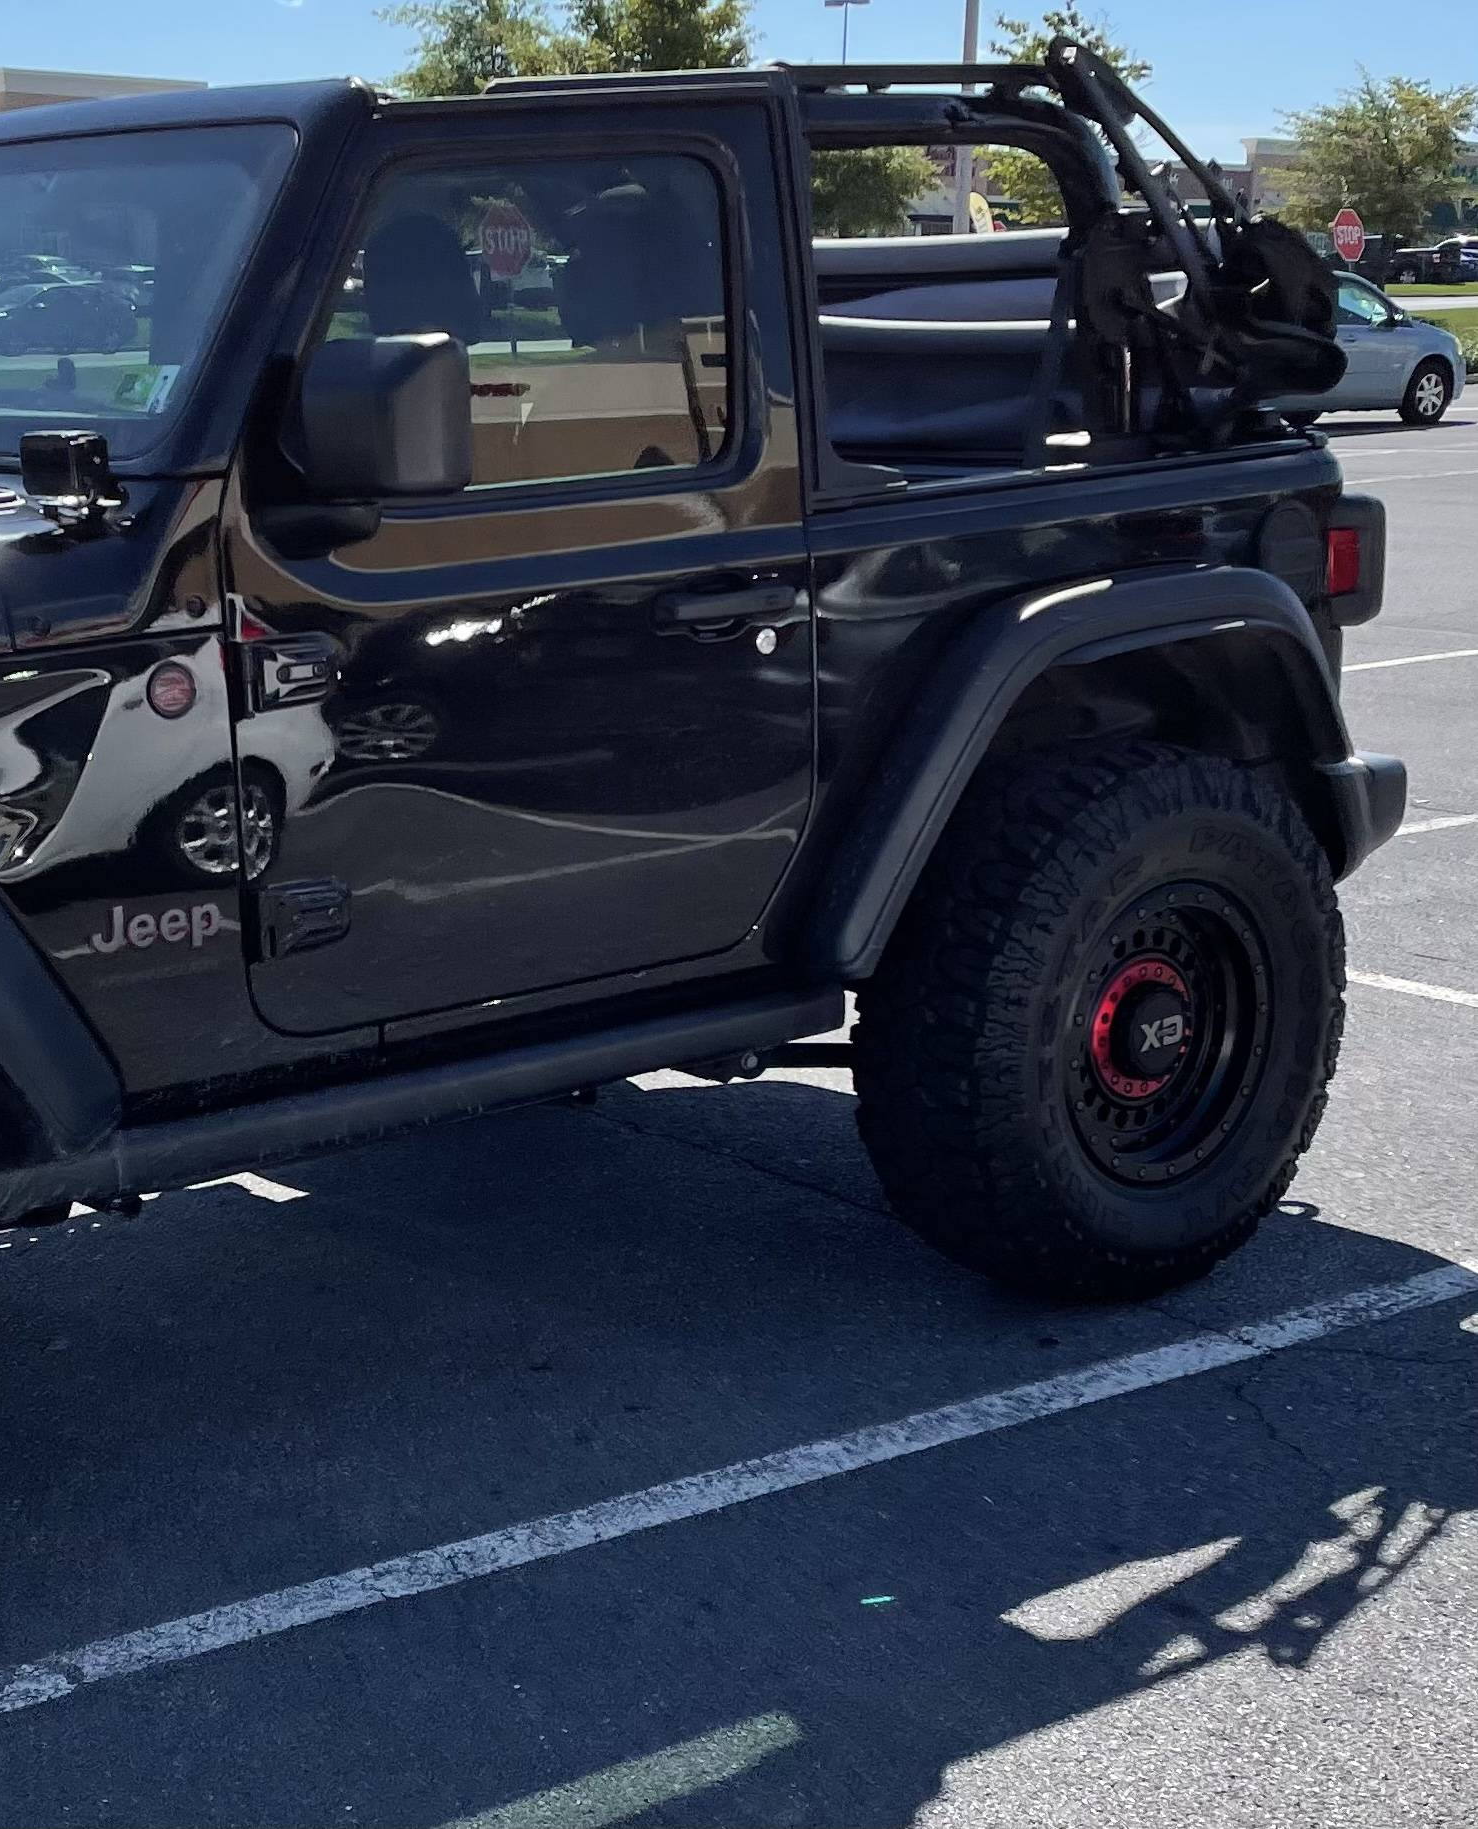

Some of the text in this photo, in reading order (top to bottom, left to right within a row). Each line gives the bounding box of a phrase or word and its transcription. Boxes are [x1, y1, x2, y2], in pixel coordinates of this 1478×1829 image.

[484, 227, 528, 254] STOP
[1337, 225, 1361, 244] STOP
[91, 902, 223, 953] Jeep
